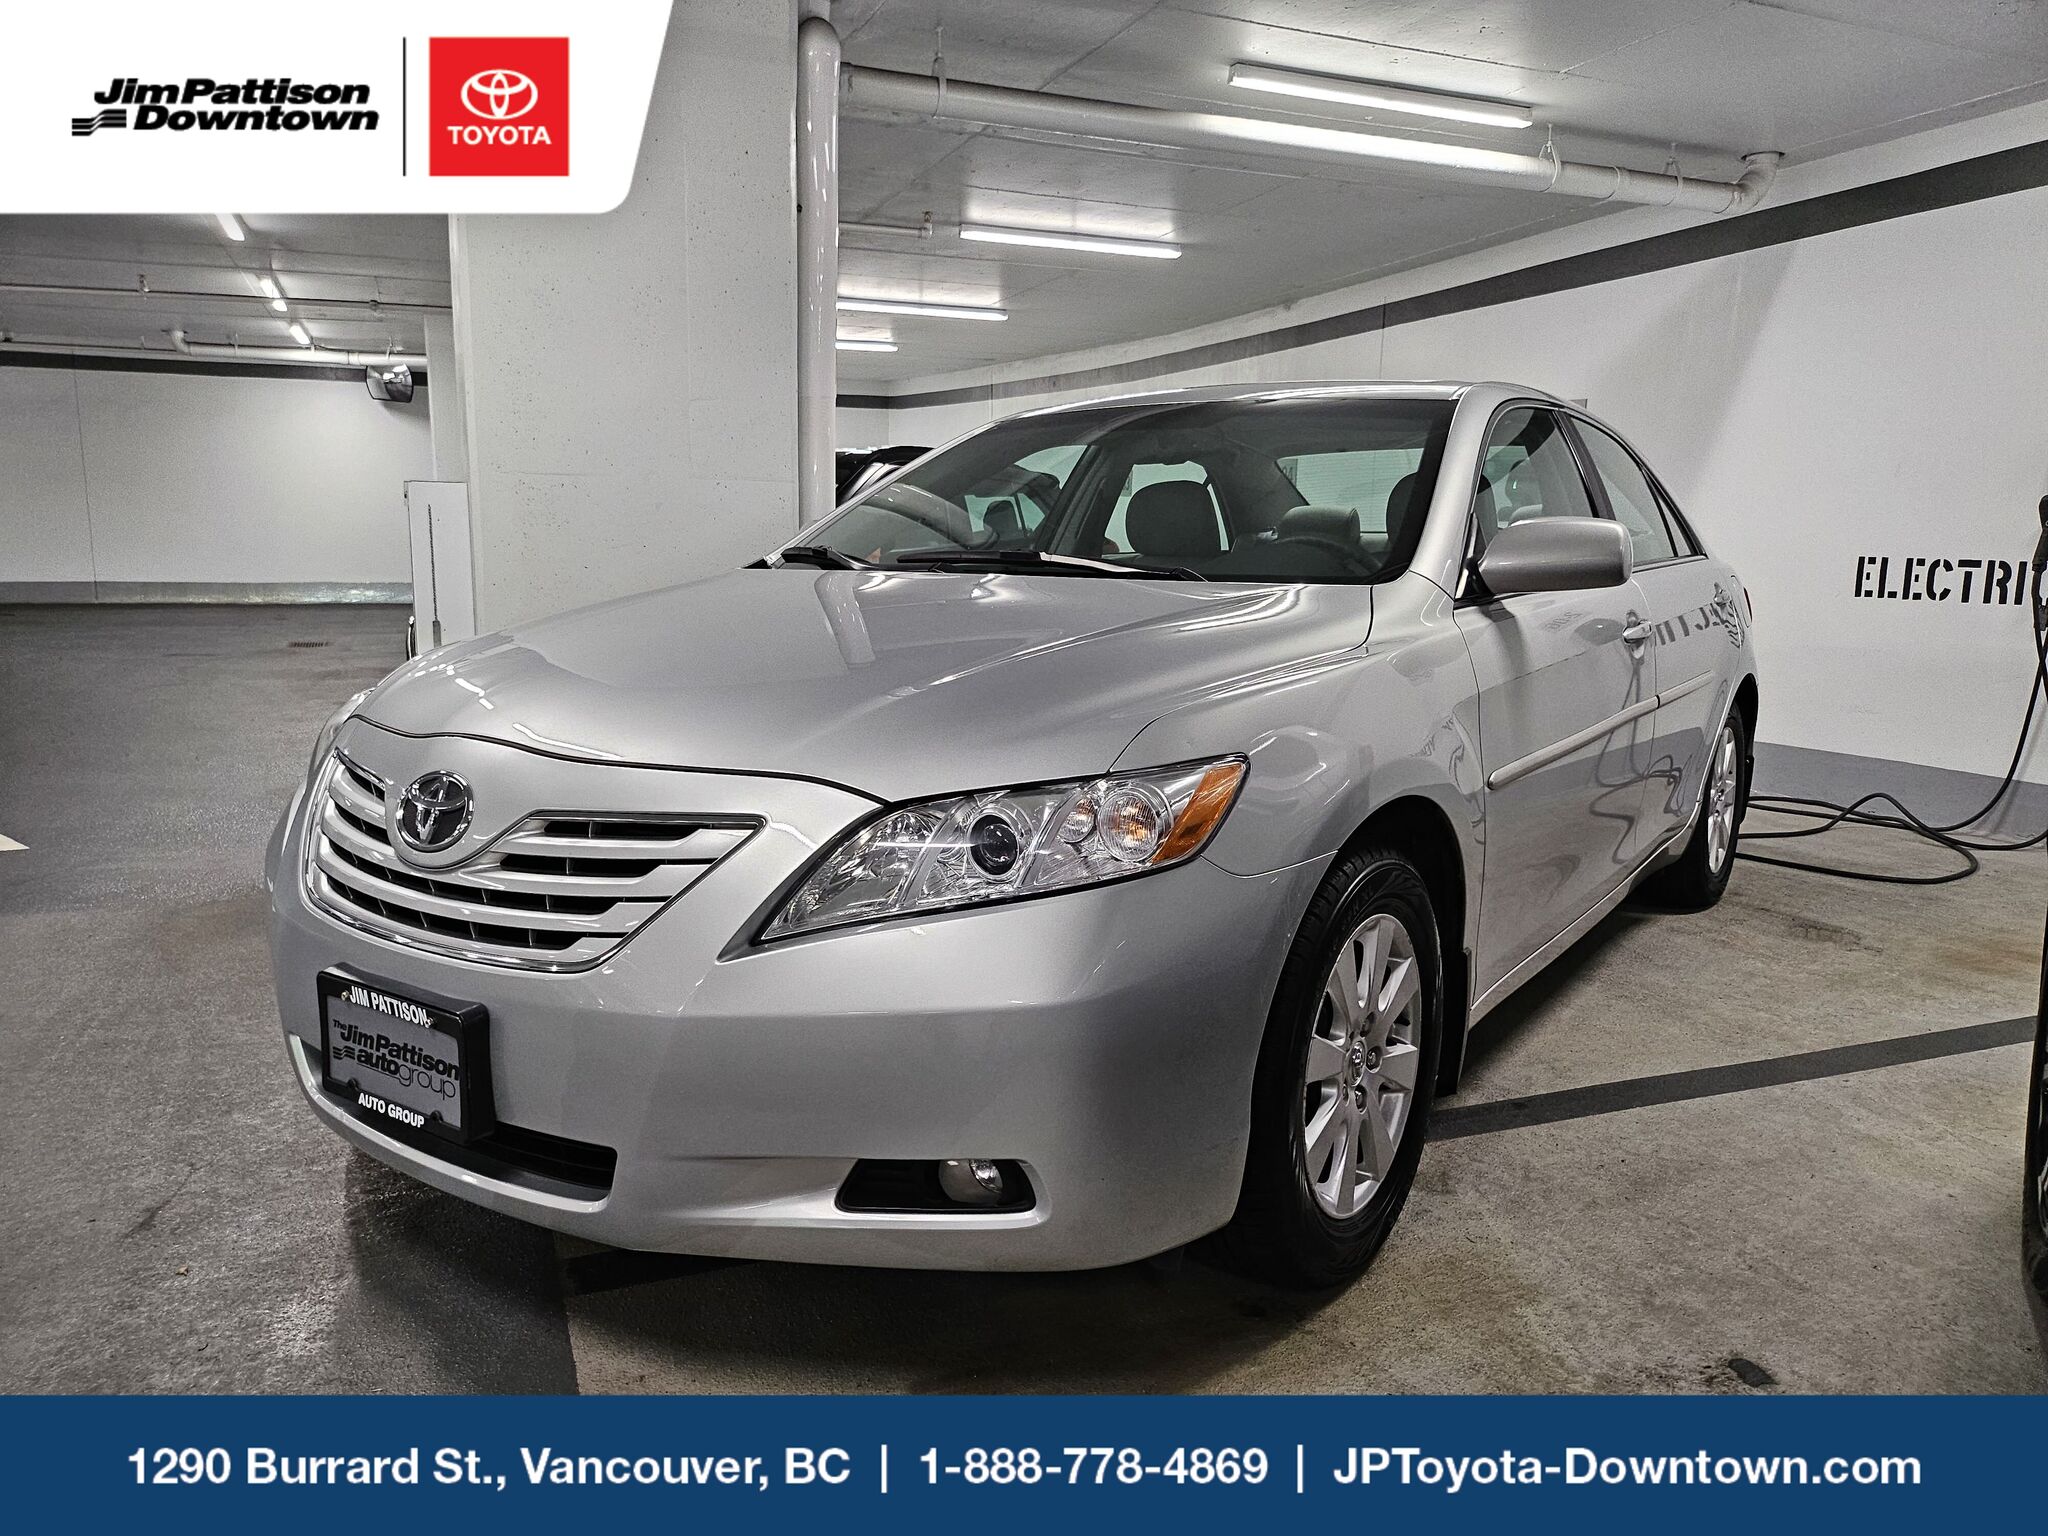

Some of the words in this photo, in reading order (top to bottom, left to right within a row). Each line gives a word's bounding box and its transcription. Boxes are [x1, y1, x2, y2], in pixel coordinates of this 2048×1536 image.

[1854, 555, 2048, 606] ELECTRI
[333, 1019, 348, 1031] The
[350, 985, 370, 1008] JIM
[370, 991, 430, 1029] PATTISON
[358, 1092, 386, 1114] AUTO
[387, 1103, 425, 1128] GROUP
